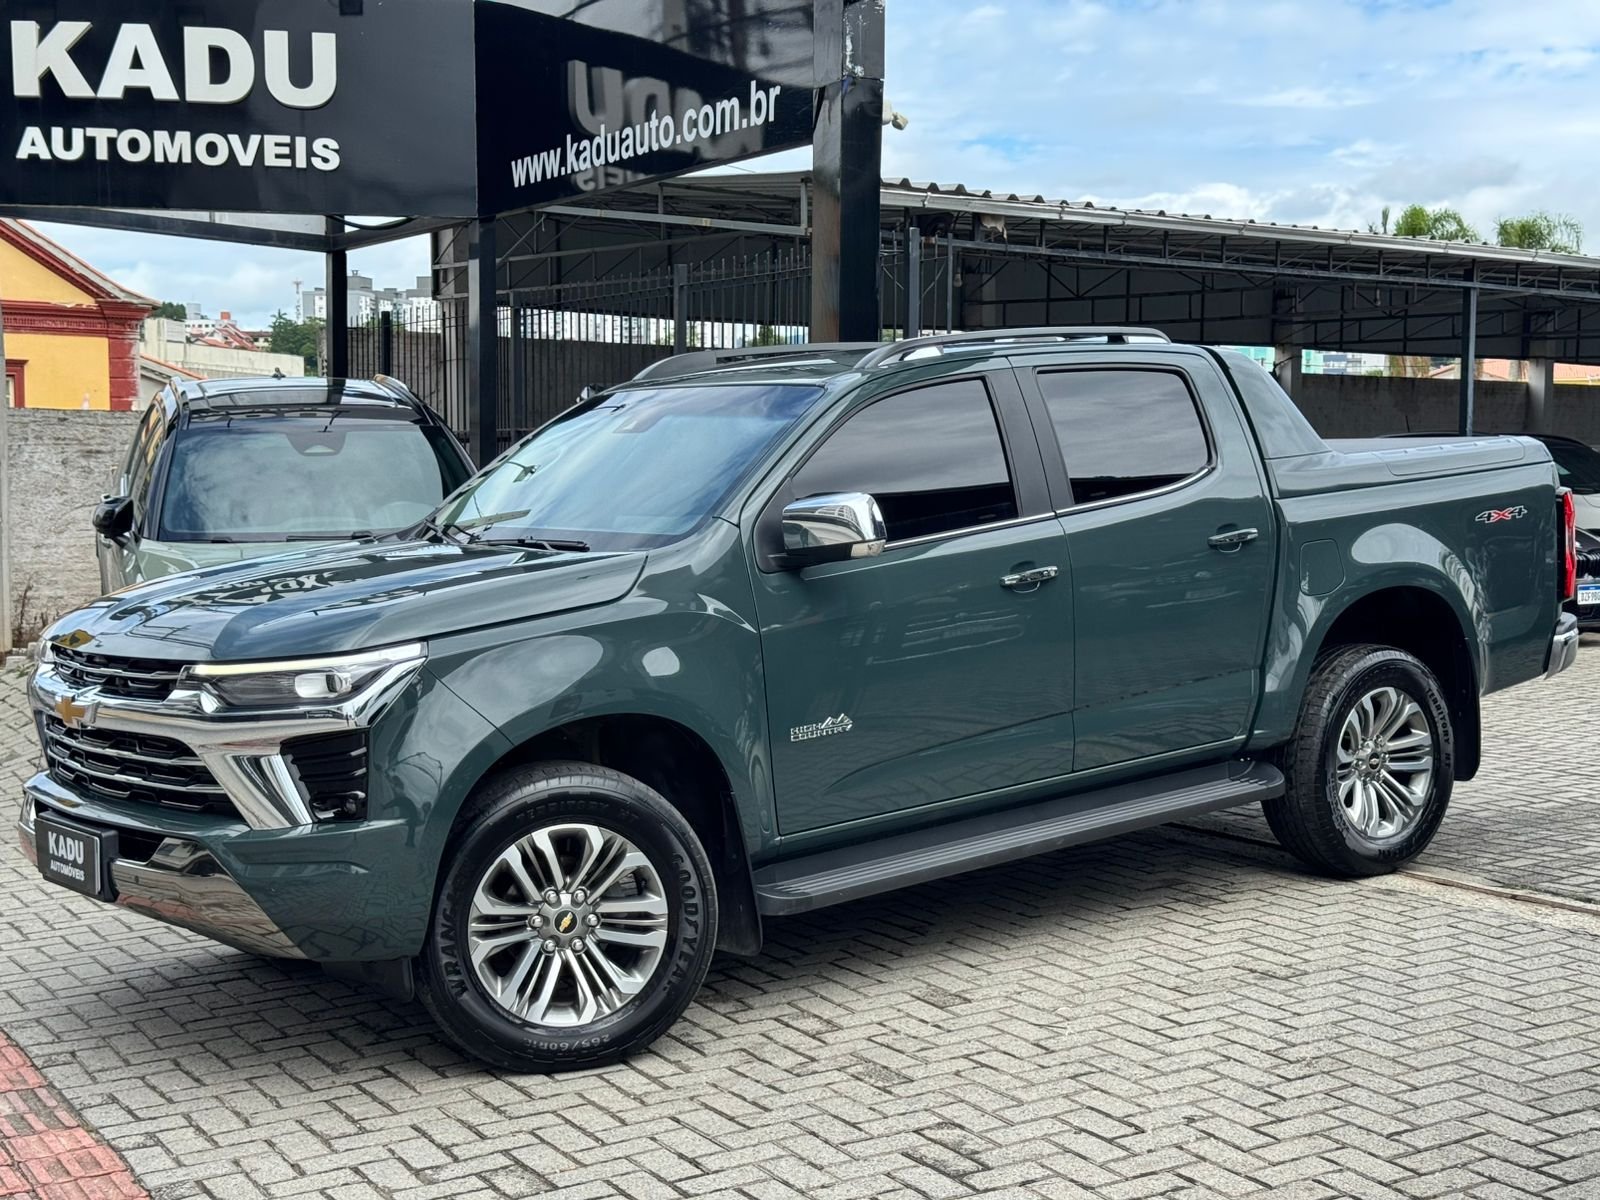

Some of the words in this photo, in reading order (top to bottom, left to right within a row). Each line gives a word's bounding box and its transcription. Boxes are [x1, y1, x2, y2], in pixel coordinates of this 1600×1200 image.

[10, 20, 337, 109] KADU
[15, 126, 341, 171] AUTOMOVEIS
[511, 79, 781, 188] www.kaduauto.com.br
[790, 722, 823, 735] HIGH
[790, 724, 853, 742] COUNTRY
[48, 831, 84, 865] KADU
[50, 859, 85, 881] AUTOMÓVEIS
